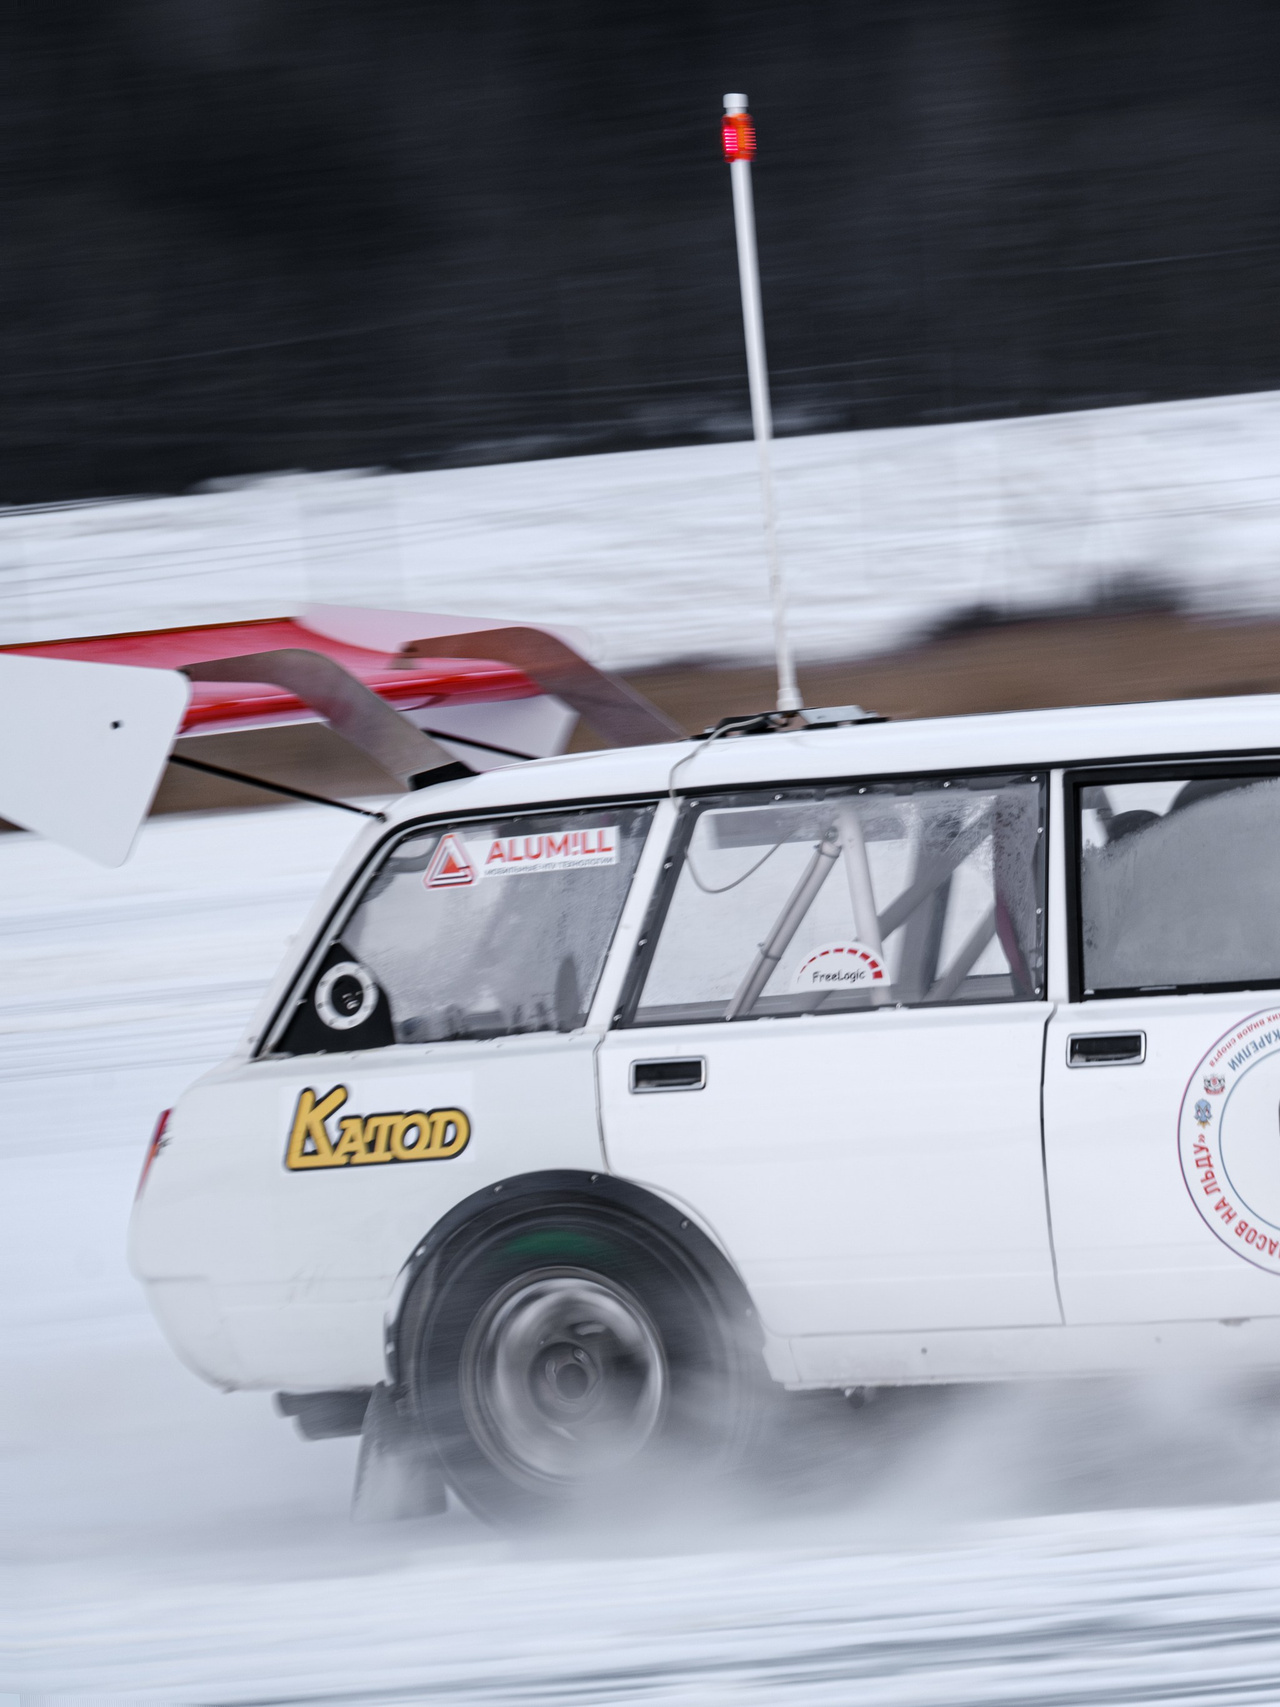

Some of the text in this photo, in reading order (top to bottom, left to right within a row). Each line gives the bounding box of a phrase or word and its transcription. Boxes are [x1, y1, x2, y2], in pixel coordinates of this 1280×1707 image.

[812, 969, 865, 983] FreeLogic
[1236, 1019, 1265, 1040] видов
[1209, 1037, 1236, 1067] спорта
[1213, 1196, 1238, 1225] НА
